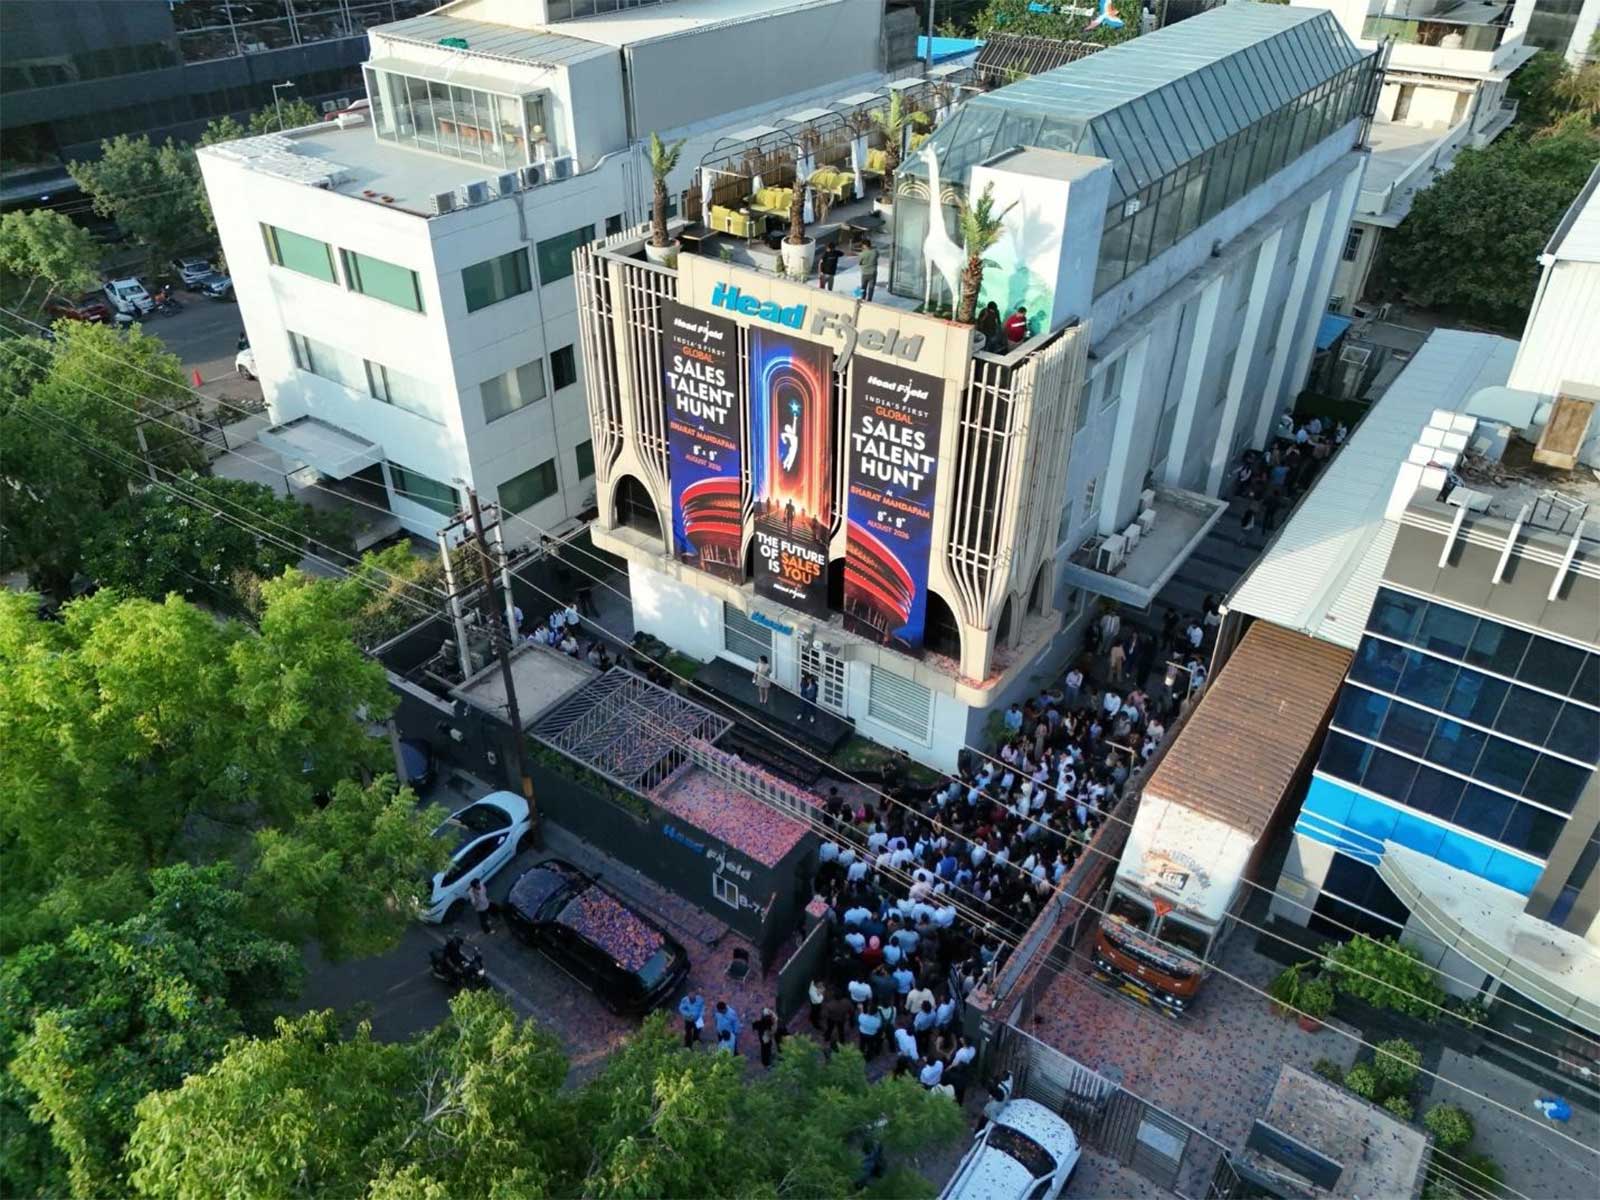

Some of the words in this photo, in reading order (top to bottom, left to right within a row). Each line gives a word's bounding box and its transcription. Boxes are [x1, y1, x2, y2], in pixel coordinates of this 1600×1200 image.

[711, 281, 808, 330] Head
[673, 318, 698, 332] Head
[673, 336, 702, 349] INDIA'S
[703, 345, 726, 357] FIRST
[682, 346, 714, 363] GLOBAL
[673, 355, 726, 387] SALES
[867, 376, 897, 390] Head
[667, 372, 735, 408] TALENT
[676, 393, 728, 425] HUNT
[865, 394, 900, 410] INDIA'S
[902, 405, 929, 418] FIRST
[875, 406, 913, 425] GLOBAL
[862, 415, 926, 451] SALES
[852, 433, 935, 474] TALENT
[861, 456, 924, 491] HUNT
[756, 531, 779, 548] THE
[781, 541, 825, 565] FUTURE
[760, 545, 779, 559] OF
[781, 552, 820, 576] SALES
[768, 559, 780, 573] IS
[783, 565, 811, 584] YOU
